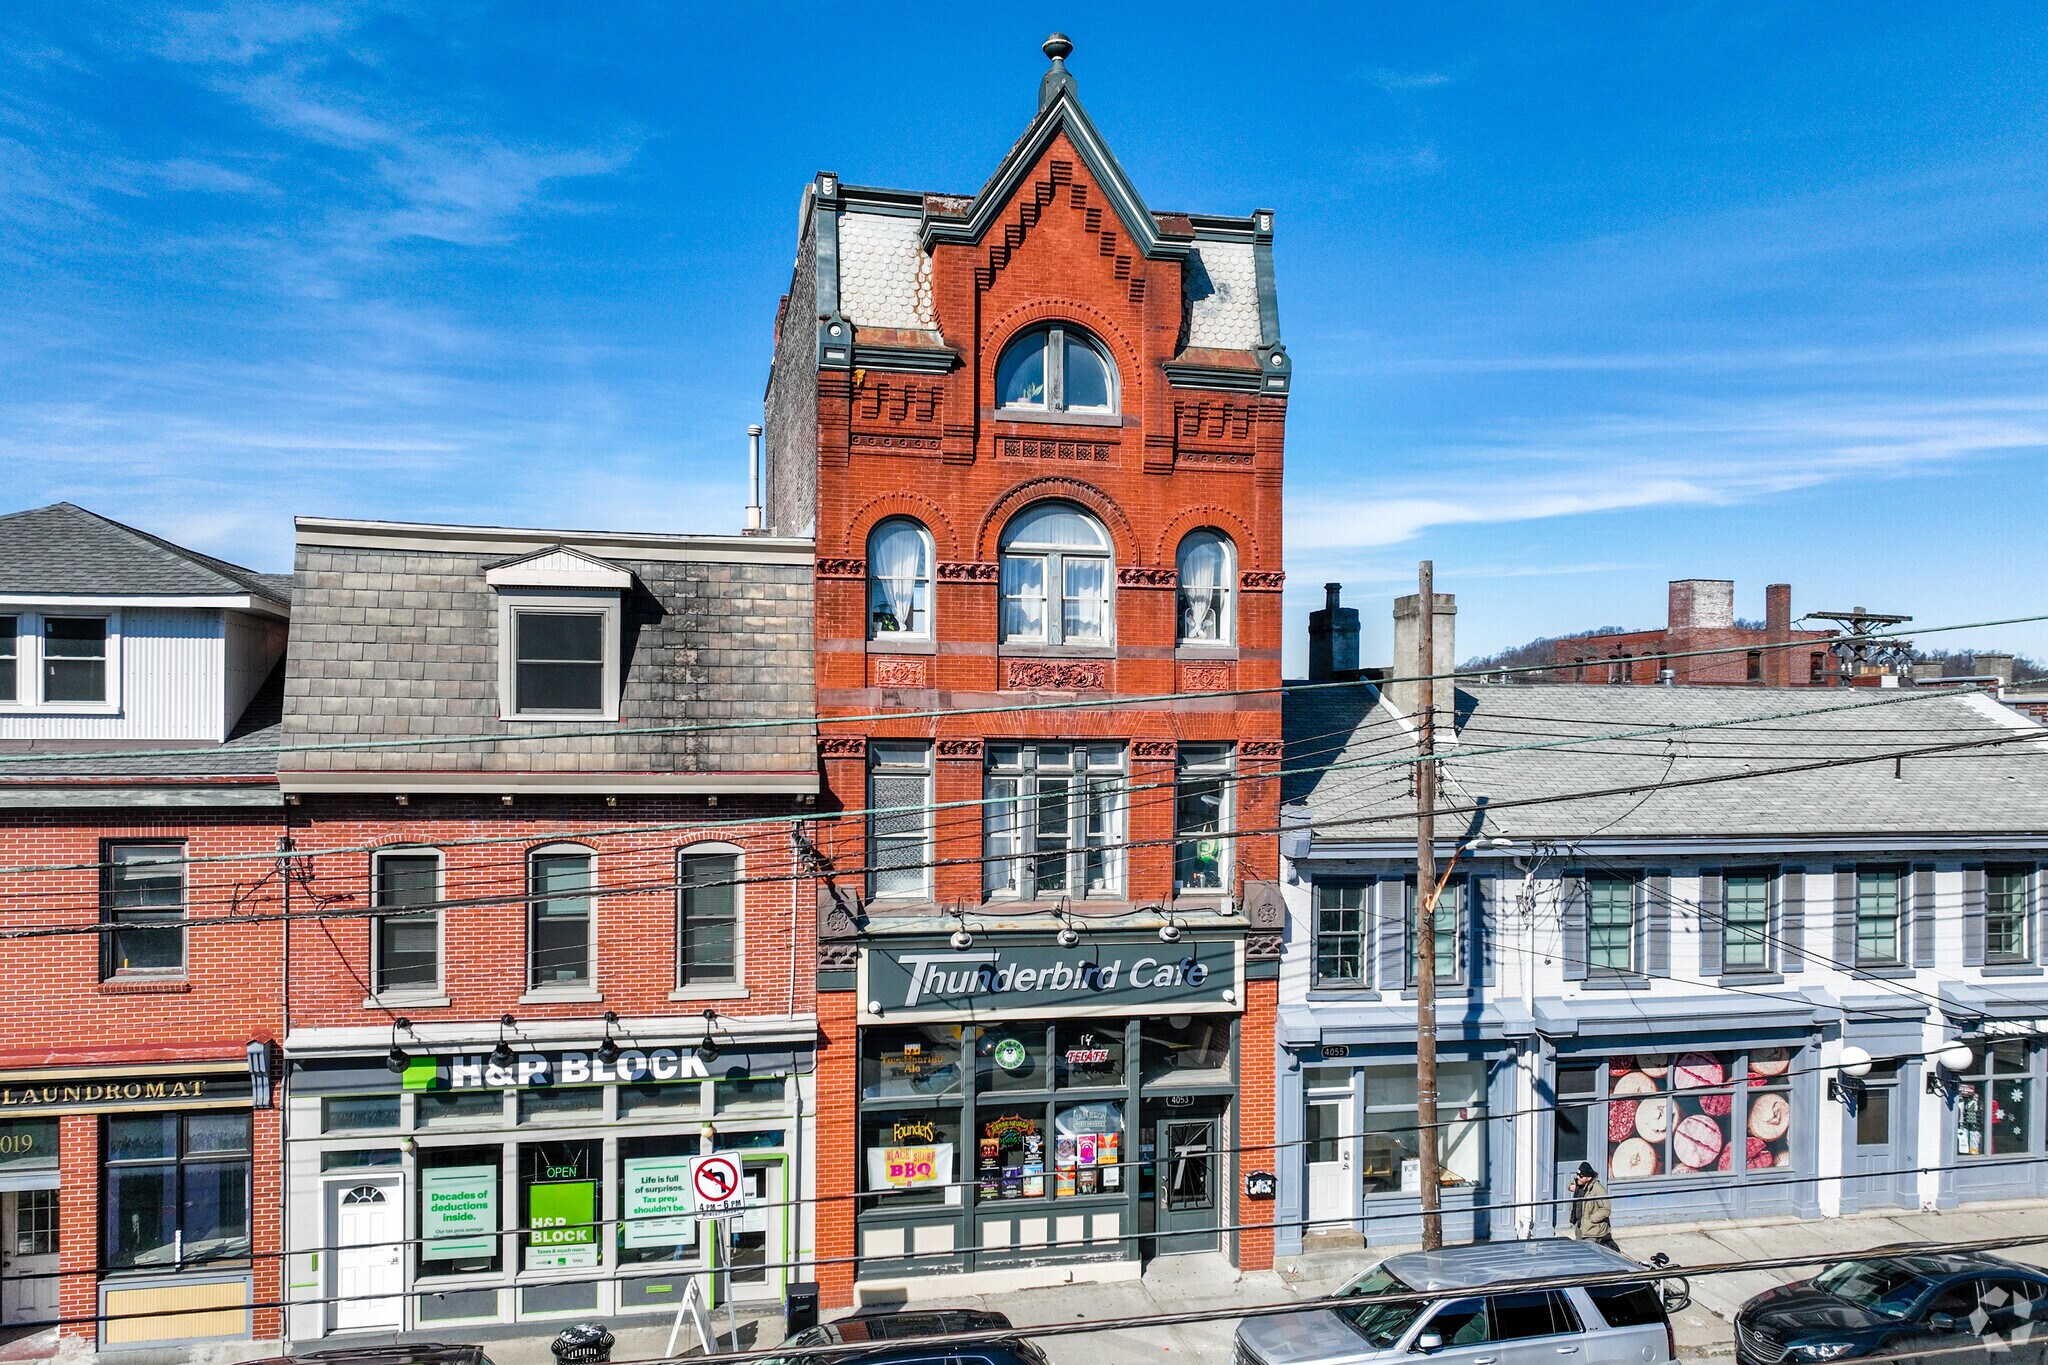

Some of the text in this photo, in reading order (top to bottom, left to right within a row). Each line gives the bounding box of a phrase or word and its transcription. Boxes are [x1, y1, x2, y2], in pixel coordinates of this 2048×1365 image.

[898, 953, 1210, 1007] Thunderbird Cafe
[1067, 1049, 1108, 1063] TECATE
[1324, 1047, 1345, 1057] 4055
[452, 1047, 710, 1087] H&R BLOCK
[904, 1064, 921, 1073] Ale
[2, 1080, 207, 1105] LAUNDROMAT
[1171, 1096, 1189, 1104] 4053
[893, 1121, 934, 1142] Founders
[0, 1134, 33, 1154] 019
[886, 1148, 936, 1163] BLACK SHEEP
[546, 1166, 577, 1178] OPEN
[890, 1162, 931, 1178] BBQ
[641, 1176, 656, 1184] Life
[645, 1185, 685, 1194] surprises.
[431, 1190, 488, 1202] Decades of
[431, 1202, 488, 1212] deductions
[633, 1204, 685, 1214] shouldn't be.
[699, 1203, 704, 1212] 4
[723, 1200, 729, 1210] 6
[731, 1199, 742, 1208] PM
[442, 1212, 476, 1222] inside.
[531, 1229, 588, 1244] BLOCK
